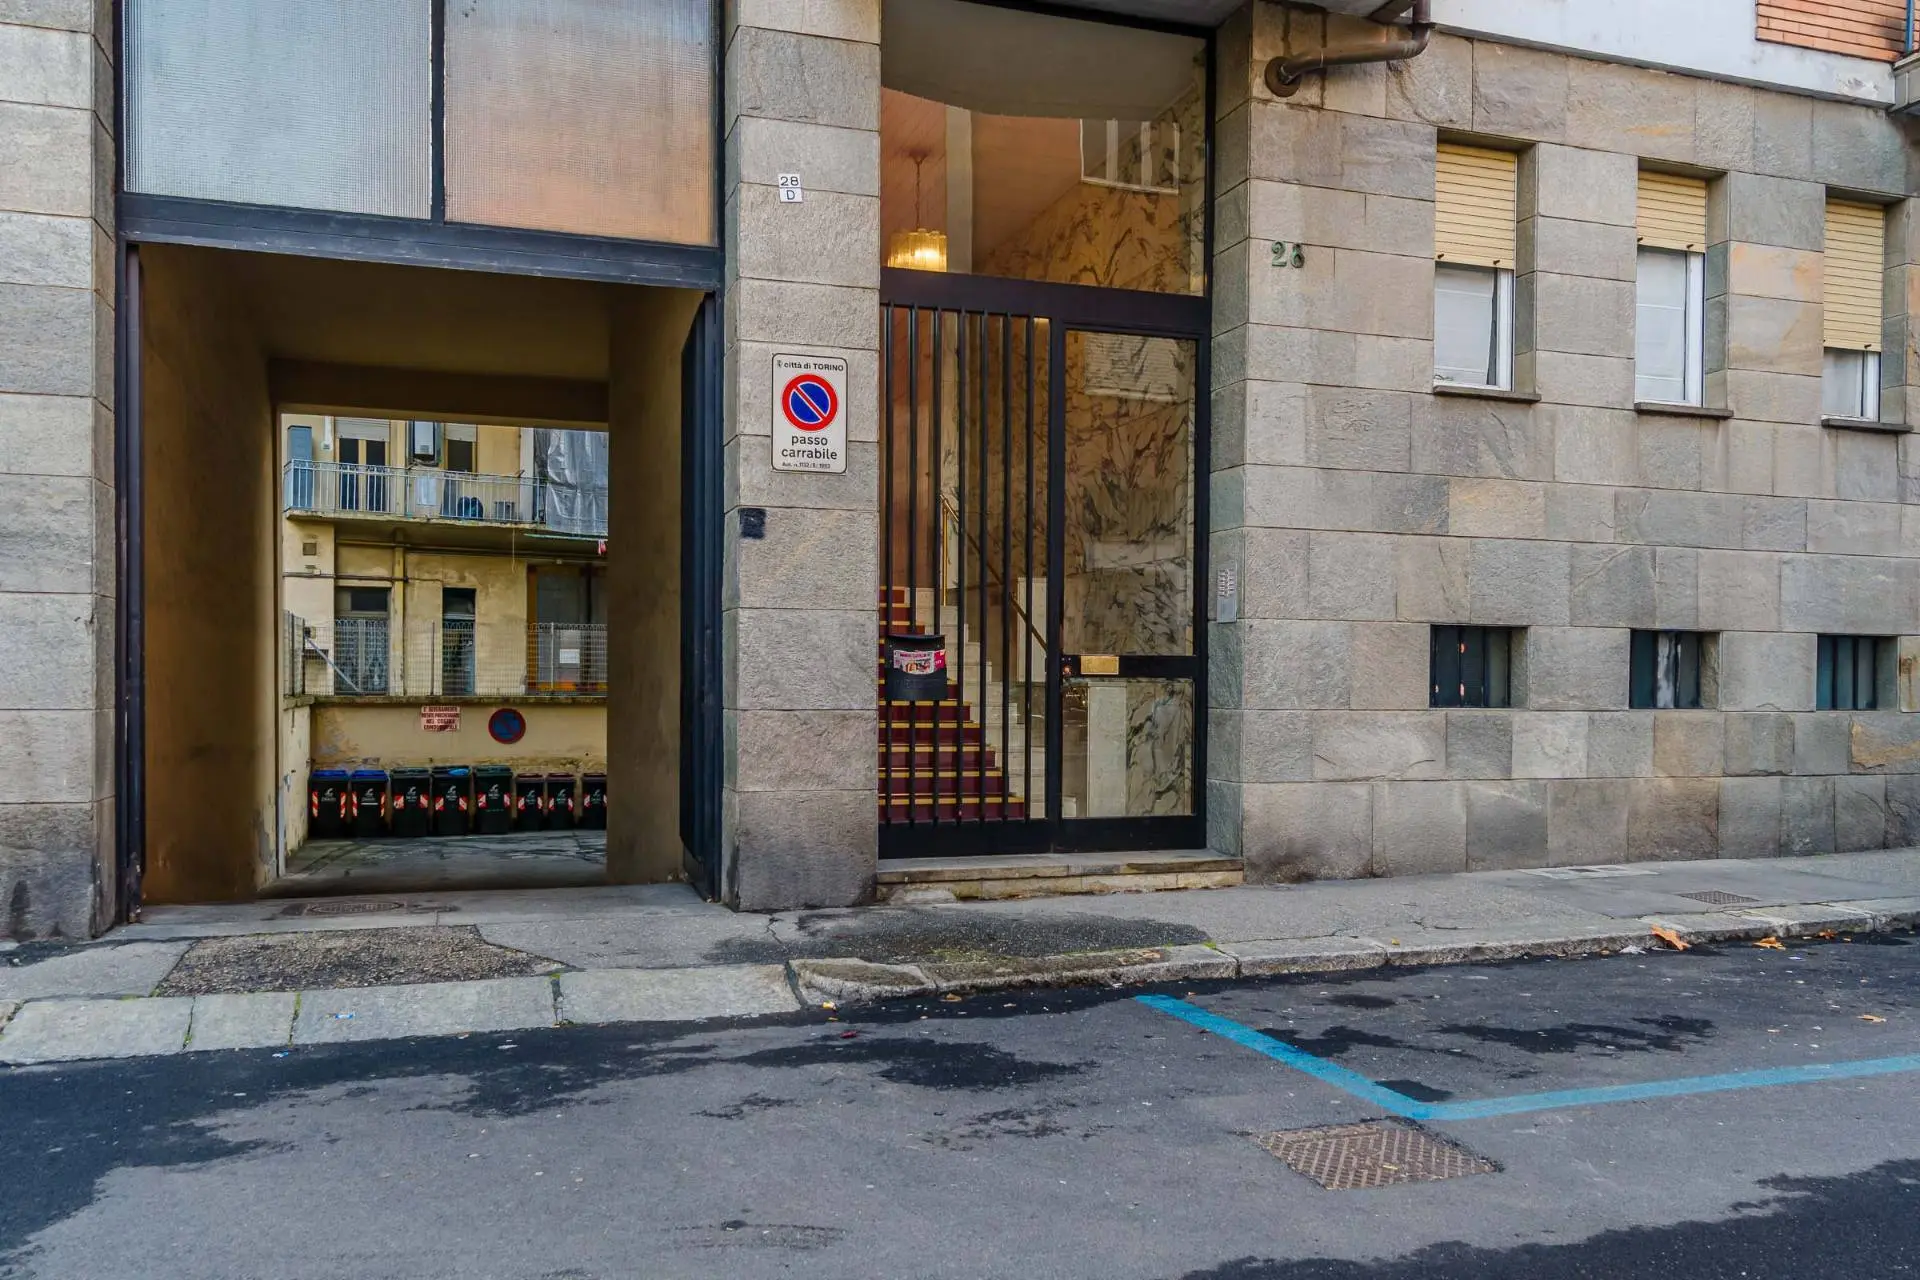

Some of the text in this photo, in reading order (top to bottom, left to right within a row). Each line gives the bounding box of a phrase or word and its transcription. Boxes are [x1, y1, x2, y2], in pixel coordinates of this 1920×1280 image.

[780, 176, 799, 186] 28
[786, 189, 795, 200] D
[1271, 241, 1305, 269] 28
[803, 362, 811, 370] di
[812, 363, 844, 372] TORINO
[791, 435, 828, 446] passo
[781, 448, 838, 460] carrabile
